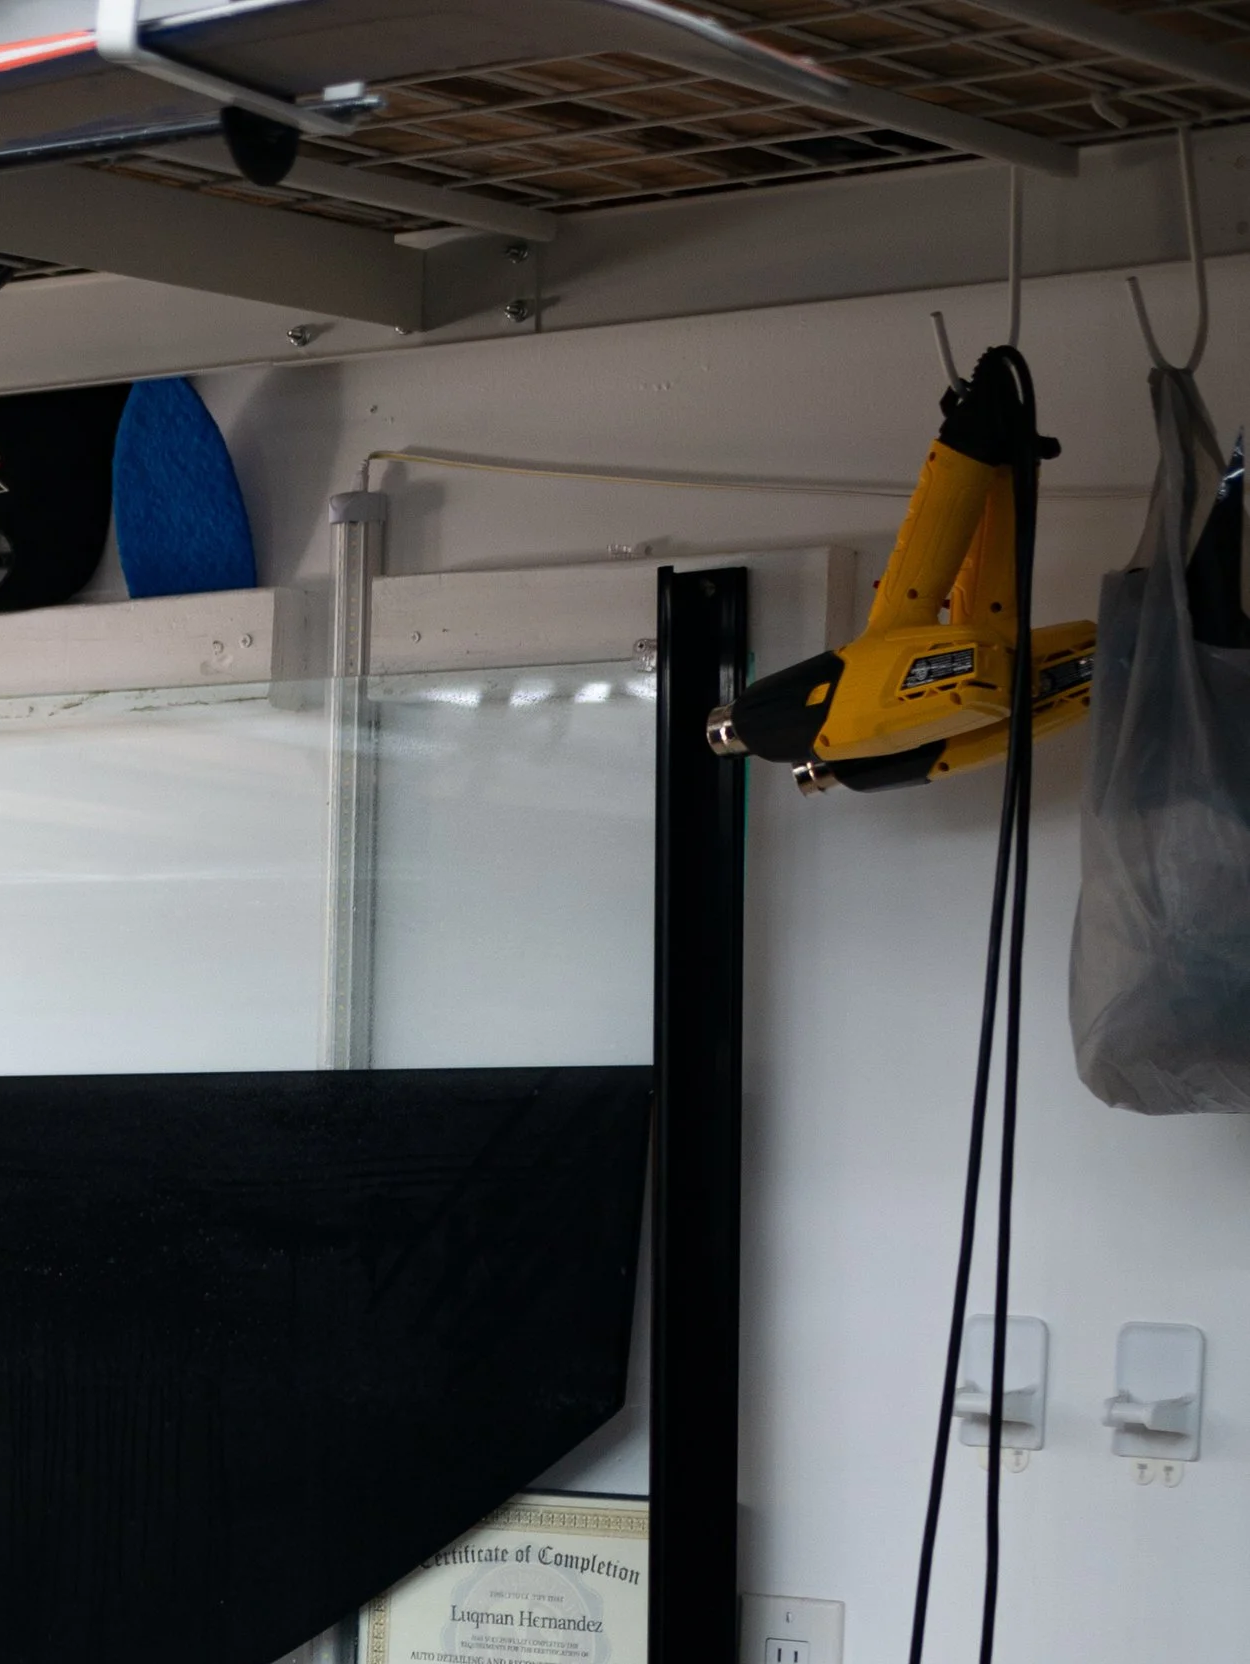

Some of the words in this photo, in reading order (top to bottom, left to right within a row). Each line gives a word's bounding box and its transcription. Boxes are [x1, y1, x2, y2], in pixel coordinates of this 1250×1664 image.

[515, 1544, 533, 1564] of
[538, 1545, 641, 1586] Completion
[450, 1604, 514, 1630] Luqman
[519, 1609, 603, 1634] Hernandez
[410, 1651, 435, 1661] AUTO
[437, 1653, 484, 1664] DETAILING
